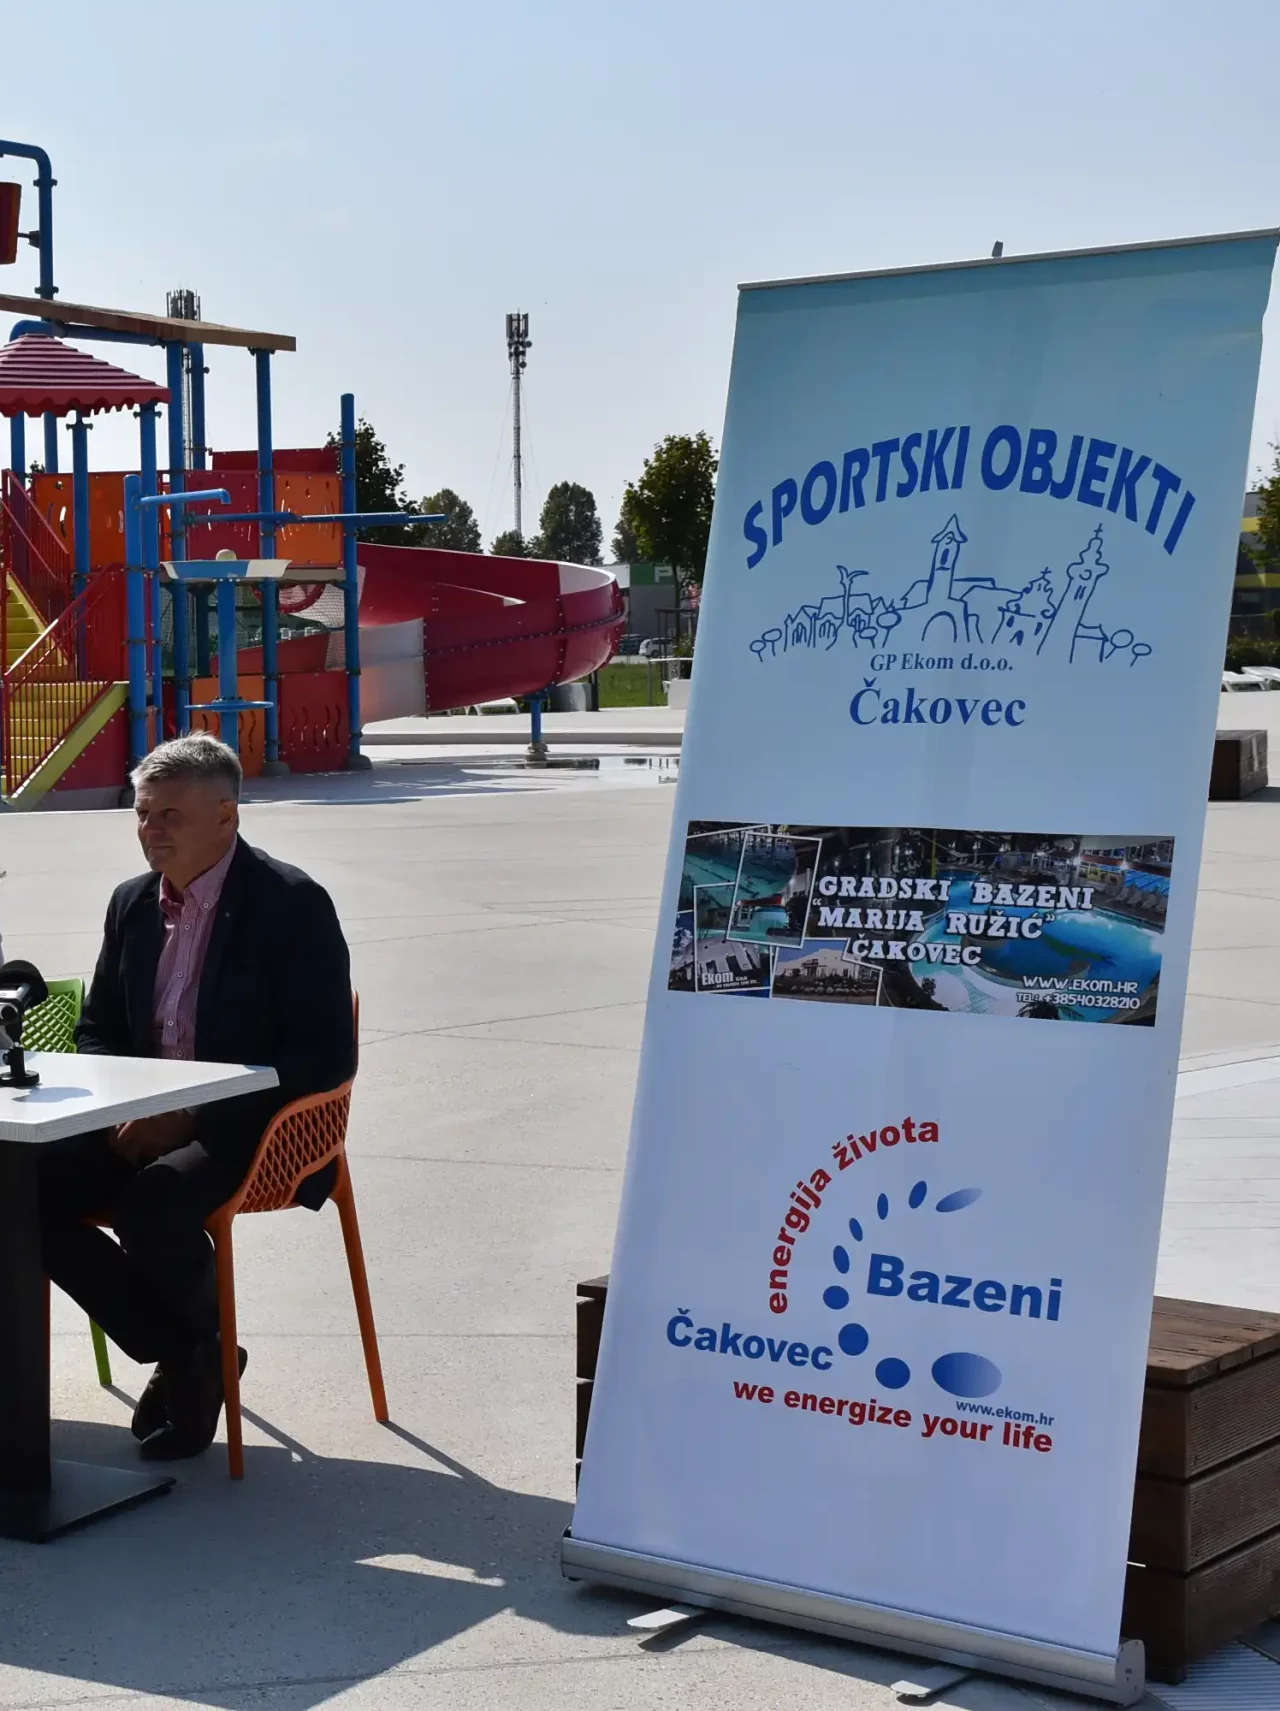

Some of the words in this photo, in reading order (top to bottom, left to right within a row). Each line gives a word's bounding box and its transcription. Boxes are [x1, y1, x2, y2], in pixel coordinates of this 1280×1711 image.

[742, 425, 971, 569] SPORTSKI
[981, 424, 1196, 556] OBJEKTI
[870, 653, 897, 671] GP
[901, 652, 954, 670] Ekom
[960, 653, 1013, 671] d.o.o.
[849, 677, 1026, 727] Čakovec
[818, 875, 952, 902] GRADSKI
[972, 881, 1095, 910] BAZENI
[851, 933, 982, 965] ČAKOVEC
[768, 1168, 833, 1314] energija
[830, 1116, 940, 1171] života
[866, 1252, 1064, 1322] Bazeni
[665, 1307, 835, 1371] Čakovec
[732, 1379, 775, 1404] we
[783, 1387, 912, 1428] energize
[920, 1412, 993, 1442] your
[1002, 1421, 1054, 1453] life
[956, 1400, 1055, 1427] www.ekom.hr
